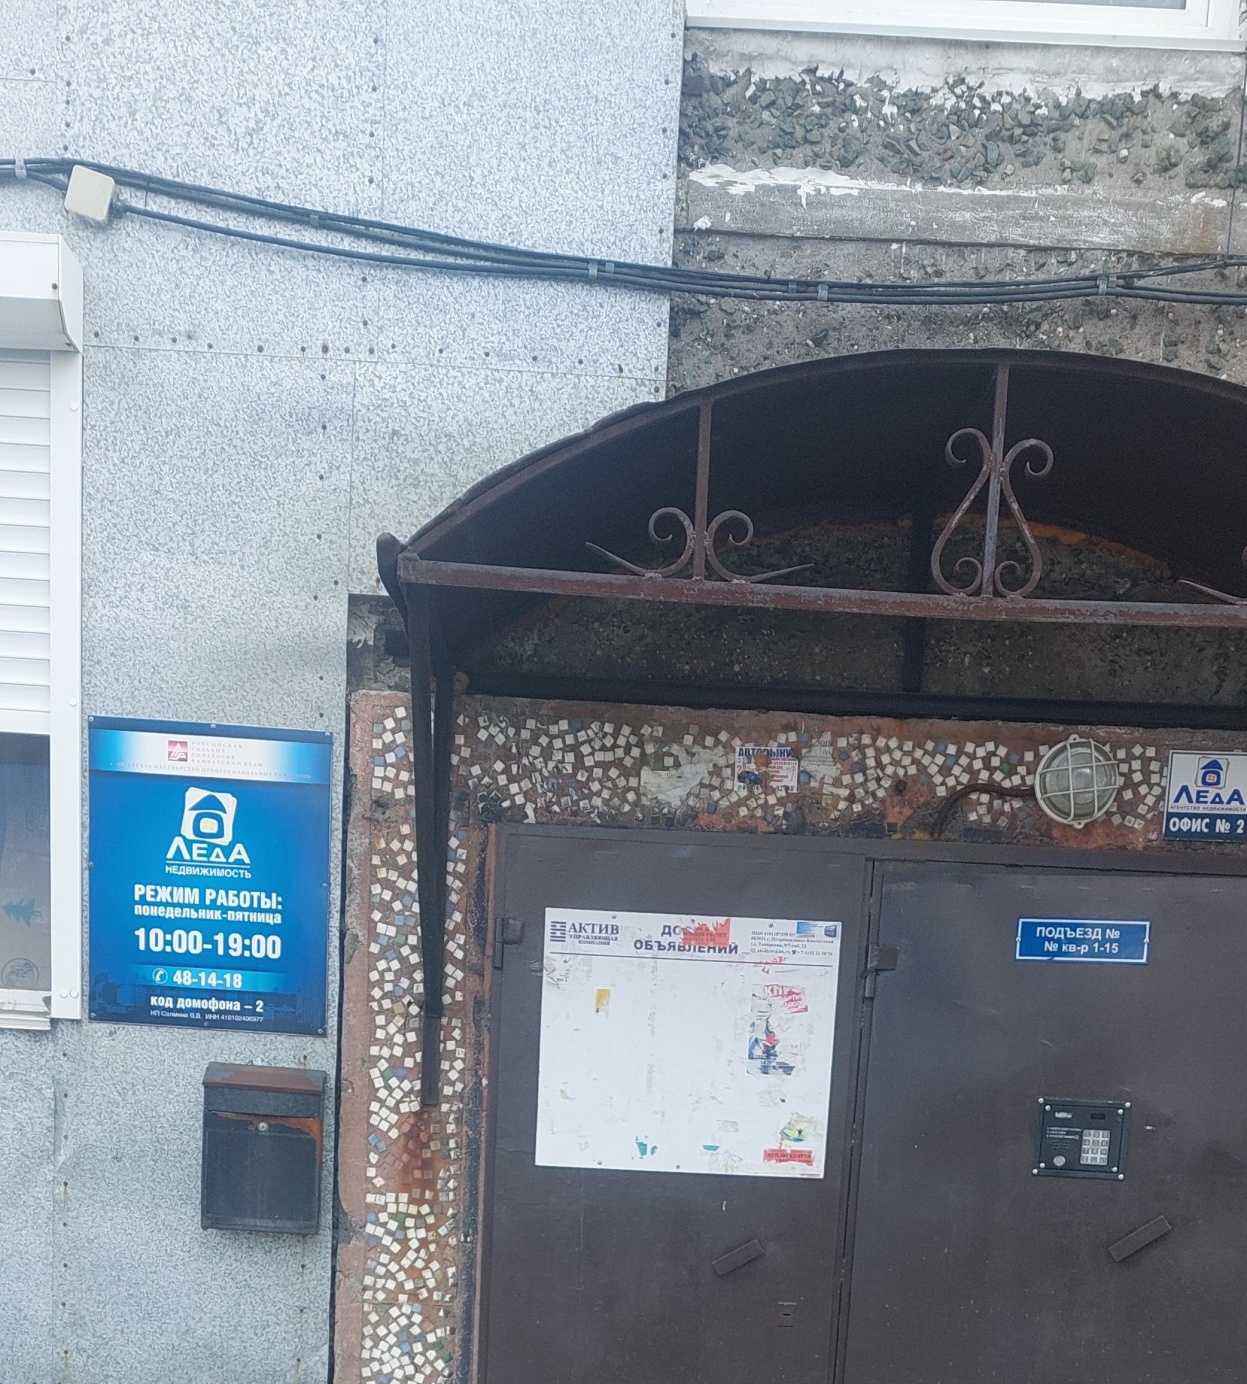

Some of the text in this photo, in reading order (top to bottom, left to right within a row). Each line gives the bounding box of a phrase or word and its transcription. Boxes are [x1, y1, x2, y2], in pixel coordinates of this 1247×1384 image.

[1173, 785, 1245, 805] ЛЕДА
[1169, 817, 1245, 833] ОФИС № 2
[165, 836, 250, 864] ЛЕДА
[165, 865, 251, 879] НЕДВИЖИМОСТЬ
[134, 884, 283, 909] РЕЖИМ РАБОТЫ:
[134, 905, 282, 925] понедельник-пятница
[569, 922, 619, 934] АКТИВ
[1036, 927, 1121, 940] ПОДЪЕЗД №
[134, 928, 282, 960] 10:00-19:00
[634, 939, 738, 954] ОБЪЯВЛЕНИЙ
[1044, 942, 1119, 956] № кв-р 1-15
[173, 969, 243, 989] 48-14-18
[150, 996, 173, 1009] код
[177, 998, 241, 1012] домофона
[255, 1001, 264, 1012] 2
